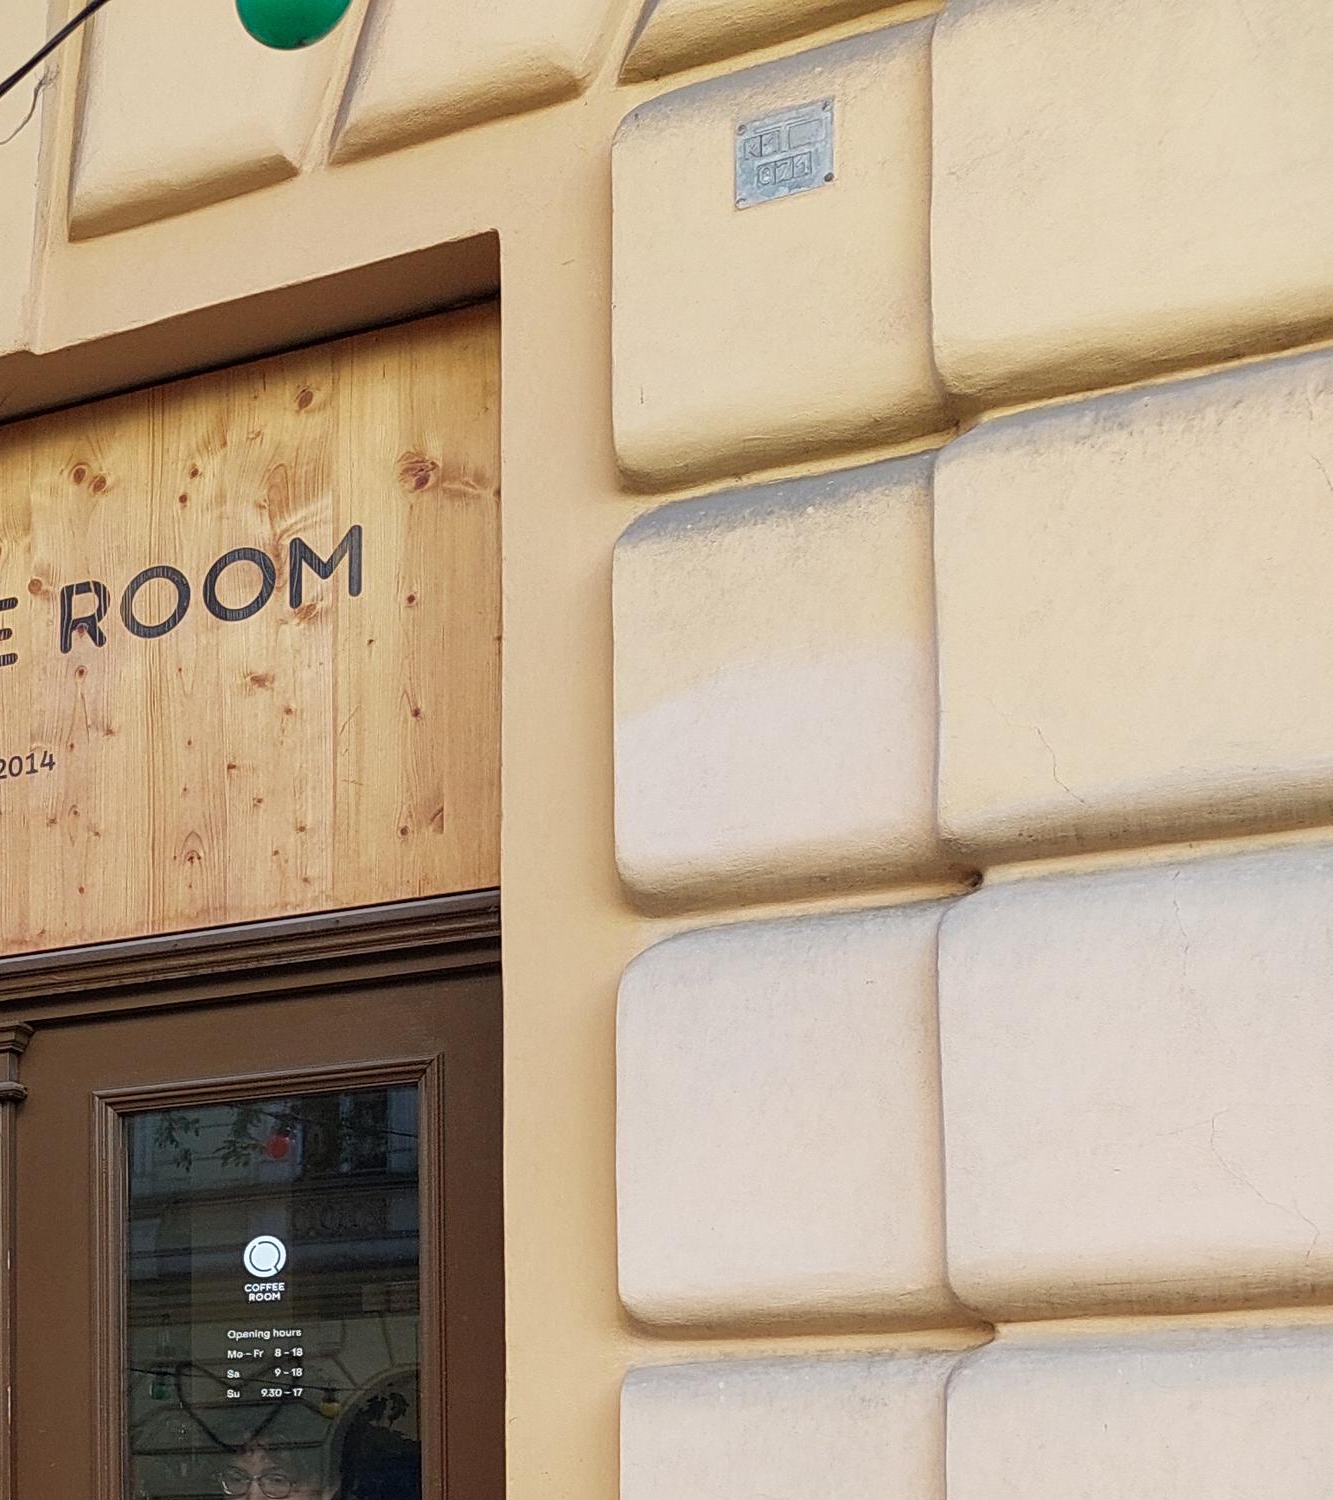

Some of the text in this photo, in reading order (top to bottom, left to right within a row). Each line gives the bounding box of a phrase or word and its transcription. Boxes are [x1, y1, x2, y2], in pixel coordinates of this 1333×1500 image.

[59, 524, 363, 655] ROOM
[244, 1282, 285, 1293] COFFEE
[248, 1292, 281, 1302] ROOM
[227, 1329, 302, 1342] Opening hours
[227, 1369, 240, 1379] Sa
[227, 1389, 240, 1398] Su
